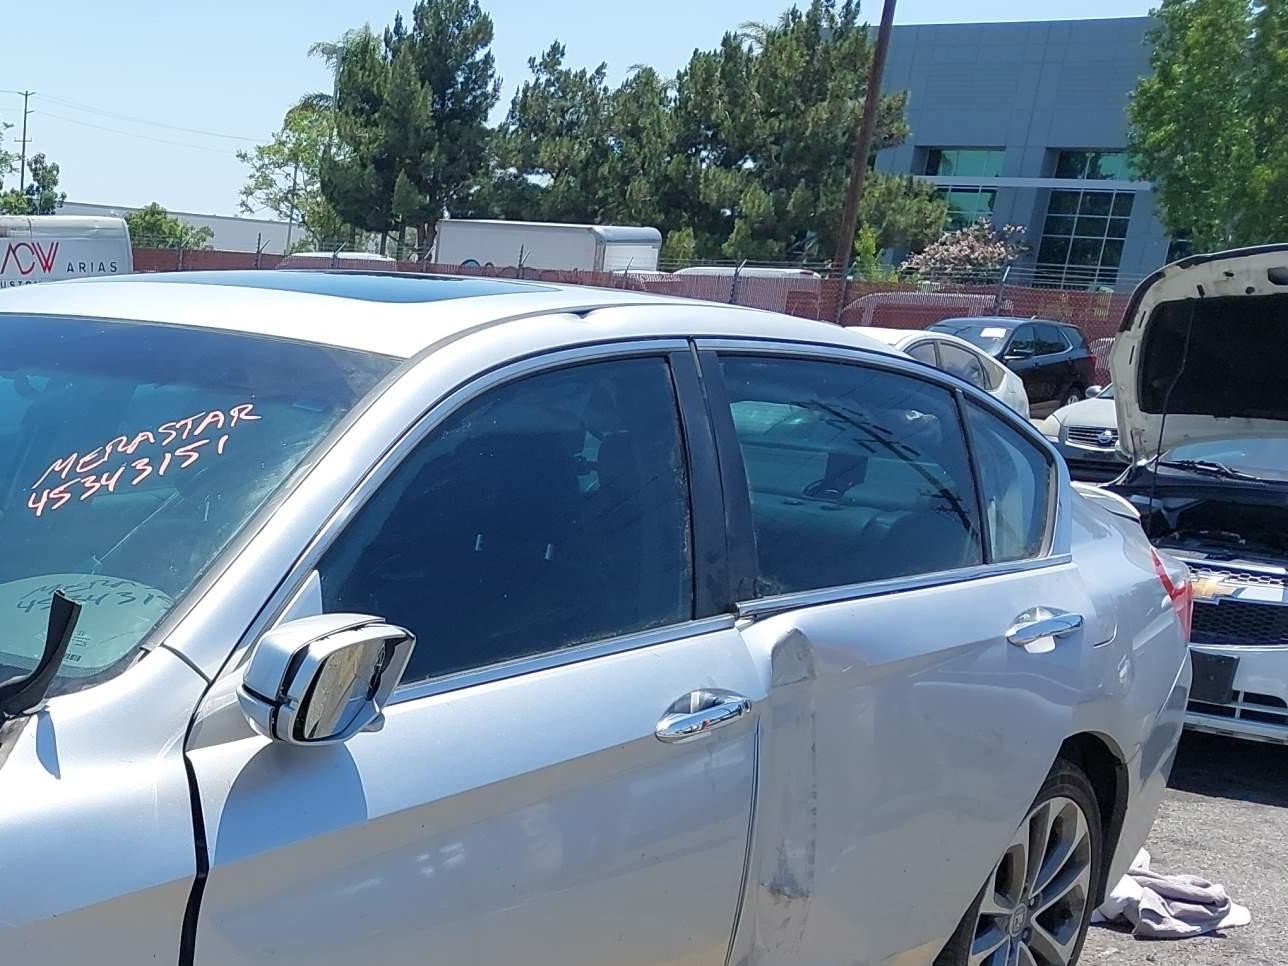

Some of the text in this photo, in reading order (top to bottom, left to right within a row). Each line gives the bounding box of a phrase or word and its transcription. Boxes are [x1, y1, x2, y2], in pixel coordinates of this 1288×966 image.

[66, 261, 118, 273] ARIAS
[27, 434, 229, 517] 45343151
[31, 403, 262, 490] MERASTAR
